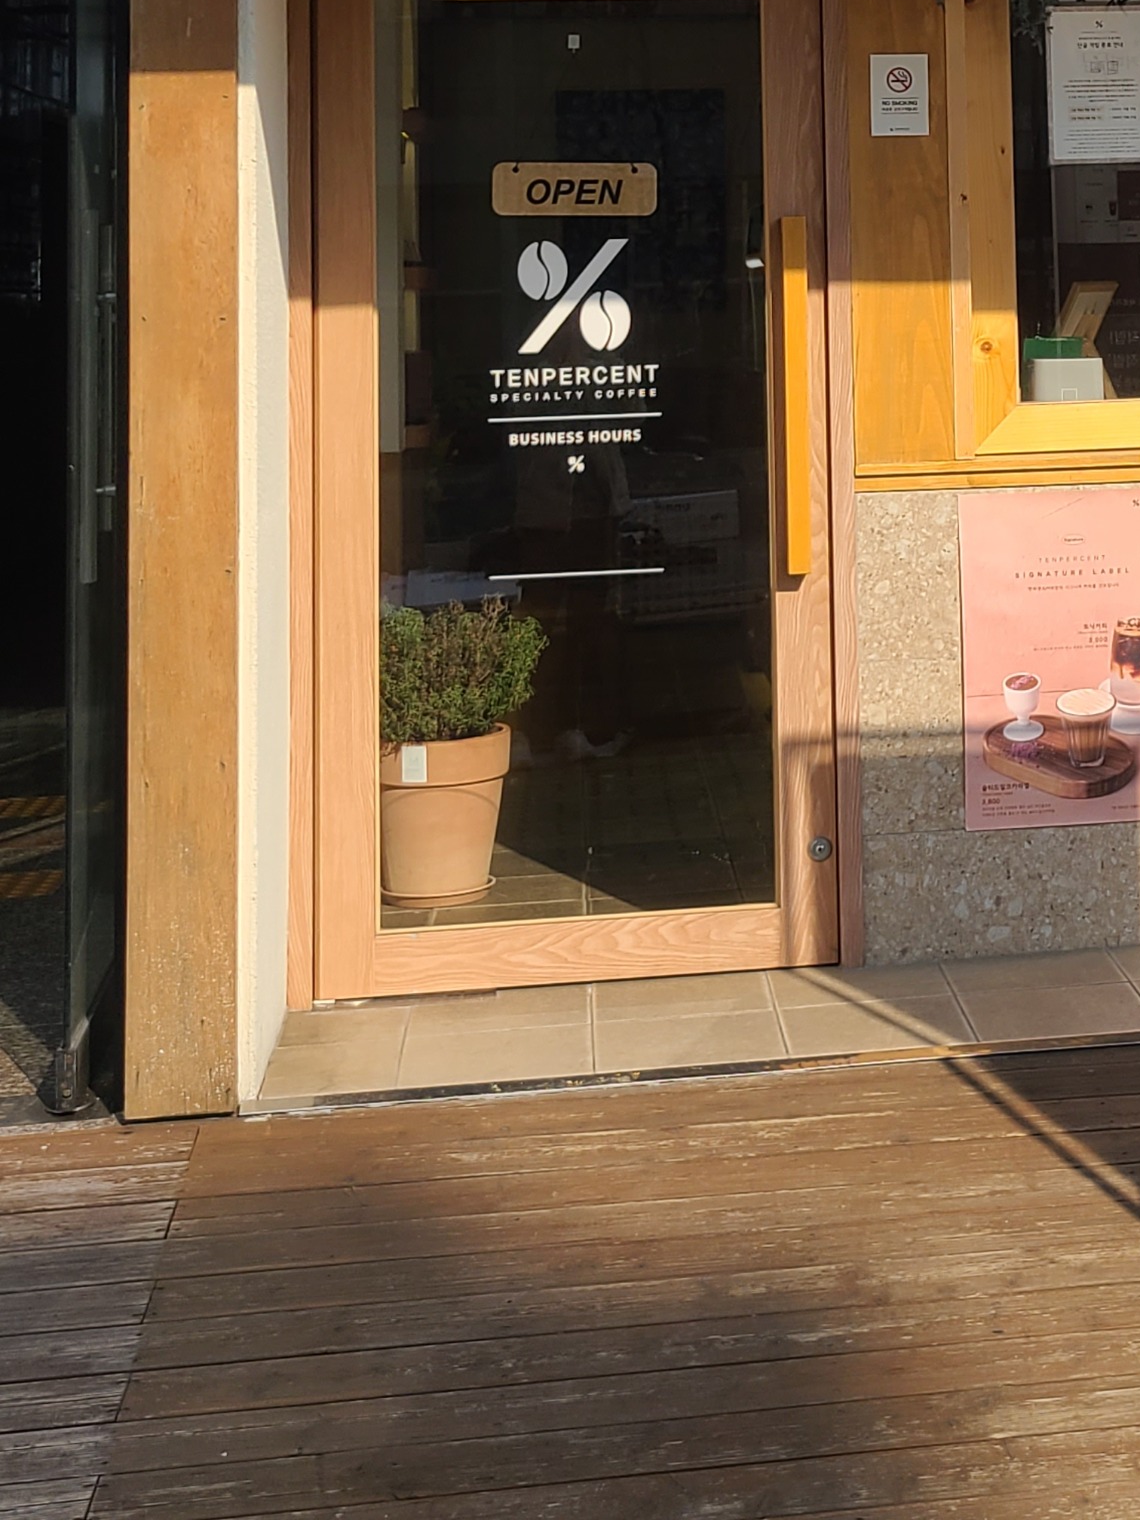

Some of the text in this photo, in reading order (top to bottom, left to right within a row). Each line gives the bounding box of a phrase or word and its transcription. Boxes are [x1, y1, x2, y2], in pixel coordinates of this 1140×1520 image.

[525, 179, 624, 206] OPEN
[489, 364, 660, 388] TENPERCENT
[489, 387, 658, 403] SPECIALTY COFFEE
[508, 428, 642, 447] BUSINESS HOURS
[1038, 554, 1106, 564] TENPERCENT
[1014, 567, 1130, 579] SIGNATURE LABEL
